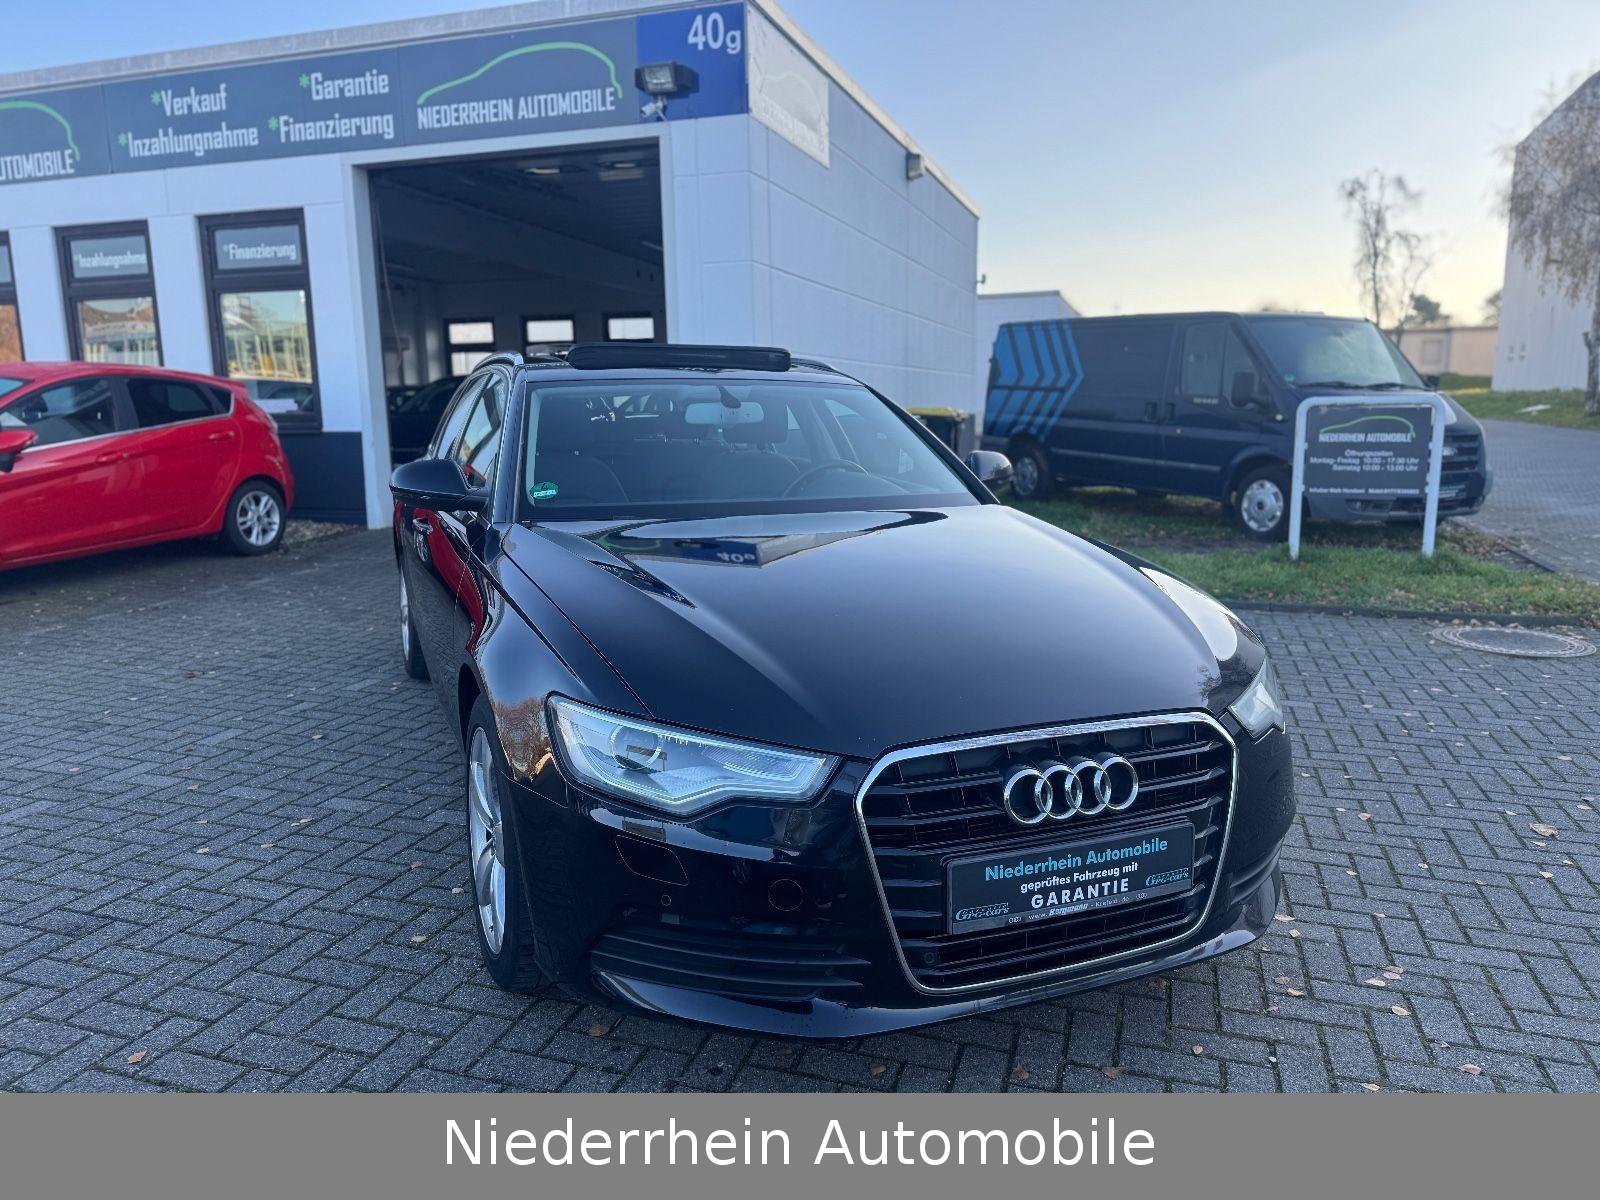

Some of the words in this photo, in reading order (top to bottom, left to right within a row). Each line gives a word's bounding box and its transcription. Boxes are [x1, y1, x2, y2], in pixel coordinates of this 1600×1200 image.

[687, 12, 742, 54] 40g
[417, 98, 514, 130] NIEDERRHEIN
[517, 87, 616, 122] AUTOMOBILE
[0, 149, 75, 180] UTOMOBILE
[1366, 433, 1412, 443] AUTOMOBILE
[985, 853, 1082, 881] Niederrhein
[1086, 837, 1168, 866] Automobile
[1020, 874, 1071, 893] geprüftes
[1073, 866, 1120, 882] Fahrzeug
[1122, 861, 1139, 873] mit
[1031, 877, 1130, 909] GARANTIE
